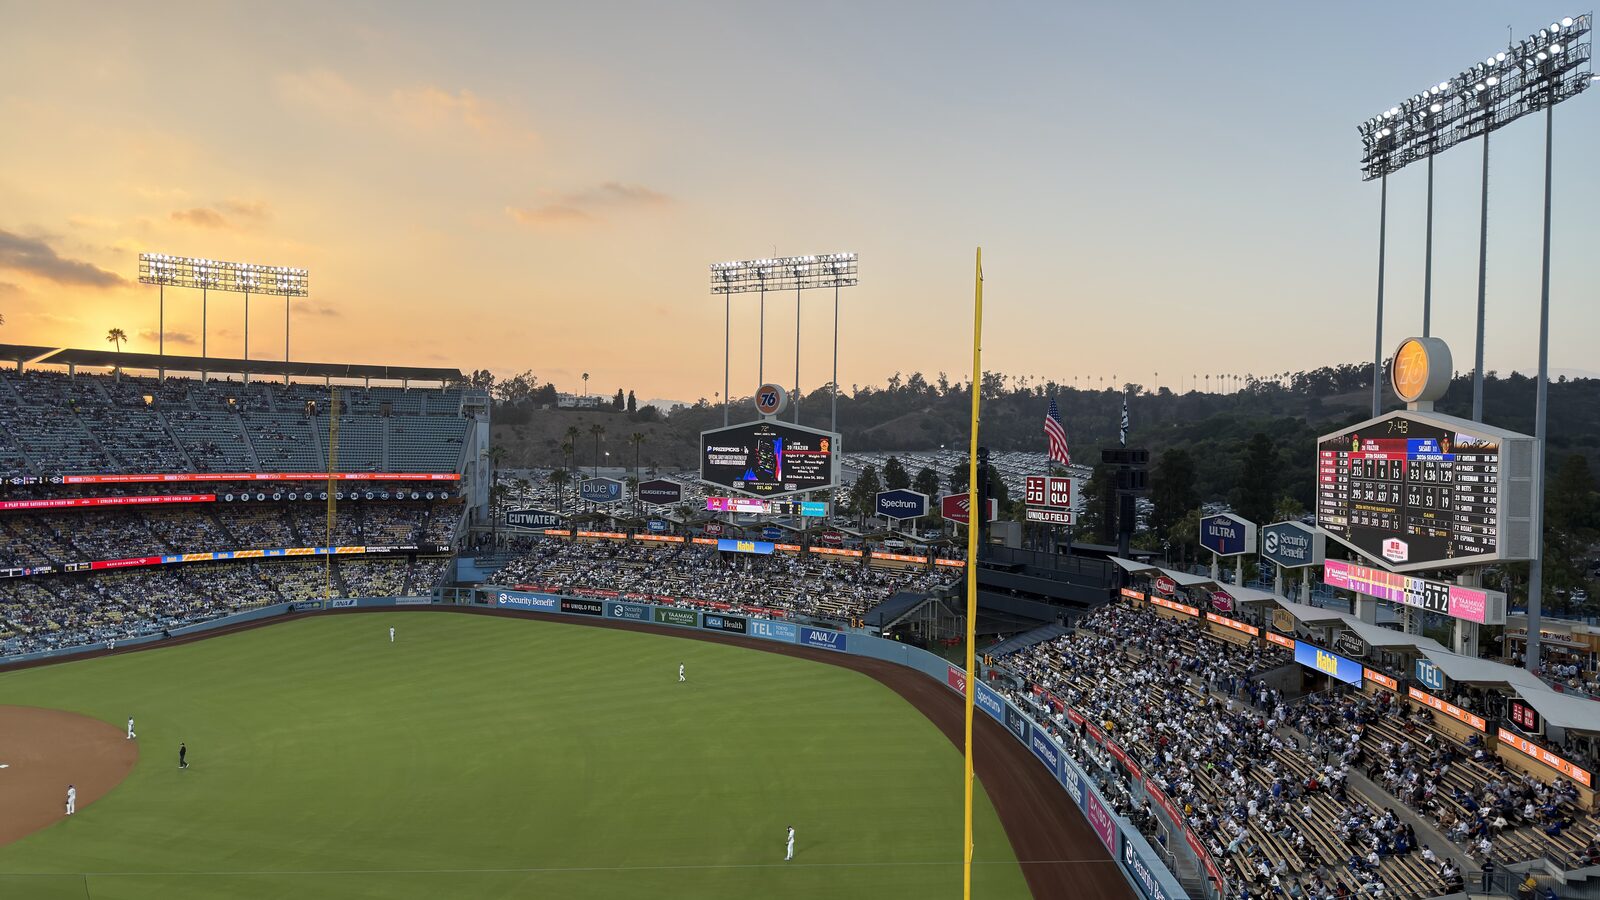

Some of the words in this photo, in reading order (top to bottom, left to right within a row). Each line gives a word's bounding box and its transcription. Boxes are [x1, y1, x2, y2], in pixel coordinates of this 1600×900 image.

[1398, 352, 1424, 385] 76
[760, 391, 777, 408] 76
[1387, 420, 1408, 434] 7:43
[1352, 467, 1362, 476] .215
[1368, 467, 1371, 477] 1
[1381, 468, 1384, 478] 6
[1393, 468, 1399, 478] 15
[1410, 469, 1419, 480] 3-3
[1424, 470, 1435, 481] 4.36
[1440, 471, 1452, 482] 1.29
[583, 482, 606, 493] blue
[1028, 480, 1042, 490] ユニ
[1051, 482, 1066, 492] UNI
[1051, 493, 1067, 504] QLO
[1352, 490, 1361, 499] .295
[1364, 491, 1374, 500] .342
[1377, 491, 1387, 502] .637
[1392, 493, 1399, 503] 79
[1409, 494, 1420, 505] 53.2
[1426, 495, 1433, 506] 53
[1442, 497, 1449, 508] 19
[881, 498, 916, 508] Spectrum
[509, 514, 555, 525] CUTWATER
[1028, 512, 1049, 521] UNIQLO
[1050, 513, 1068, 522] FIELD
[1393, 521, 1398, 529] 15
[1209, 526, 1236, 538] ULTRA
[737, 541, 754, 552] Habit
[1280, 533, 1309, 550] Security
[1280, 545, 1304, 559] Benefit
[1414, 581, 1417, 589] 0
[1420, 582, 1423, 590] 0
[508, 595, 532, 606] Security
[532, 598, 553, 607] Benefit
[1413, 596, 1416, 604] 0
[1425, 590, 1431, 607] 2
[1435, 592, 1438, 609] 1
[1441, 594, 1447, 611] 2
[588, 604, 601, 612] FIELD
[724, 620, 743, 629] Health
[753, 622, 772, 636] TEL
[810, 631, 828, 642] ANA
[1341, 634, 1363, 647] STARLUX
[1344, 642, 1360, 652] AIRLINES
[1316, 649, 1338, 676] Habit
[1418, 660, 1440, 687] TEL
[977, 688, 1000, 713] Spectrum
[1064, 761, 1078, 786] TOYO
[1066, 777, 1081, 804] TIRES
[1132, 851, 1154, 896] Security
